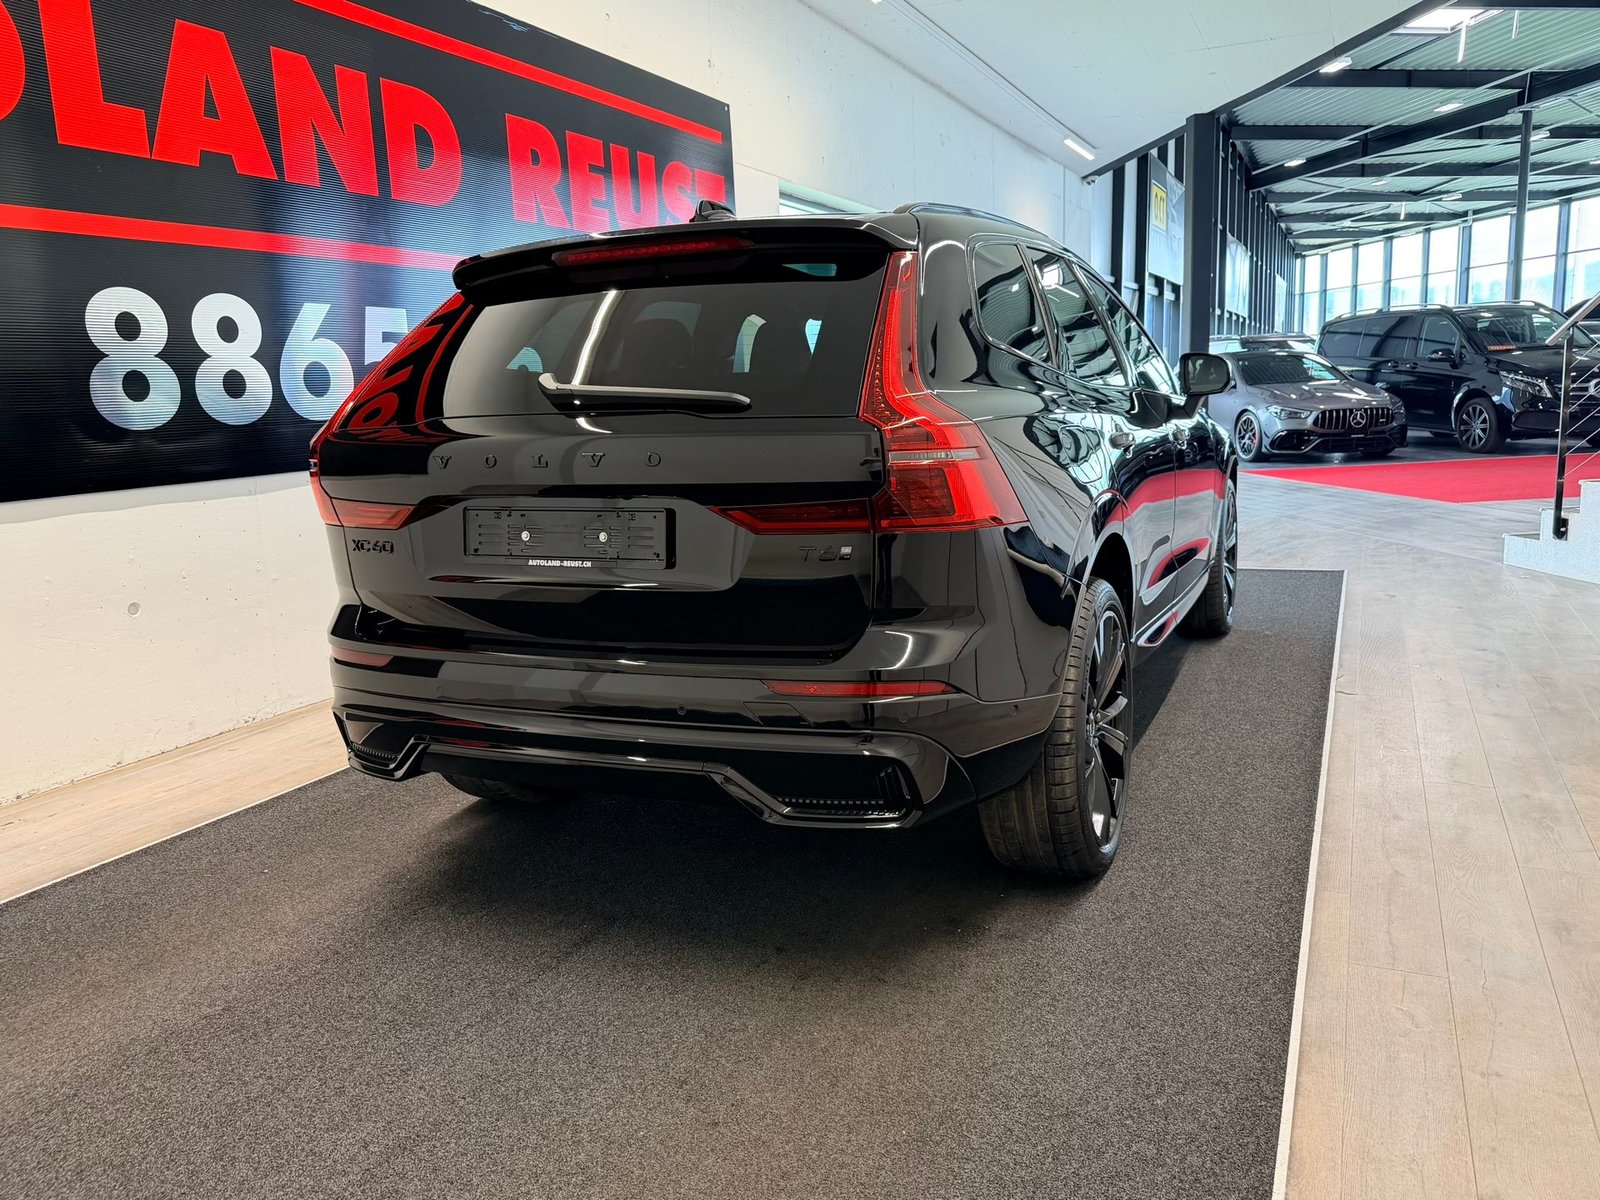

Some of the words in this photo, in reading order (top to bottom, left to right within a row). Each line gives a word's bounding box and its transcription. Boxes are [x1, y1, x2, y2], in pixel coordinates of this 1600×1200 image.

[432, 452, 662, 470] VOLVO
[351, 539, 394, 554] XC60
[799, 545, 838, 561] T6
[528, 559, 592, 568] AUTOLAND-REUST.CH
